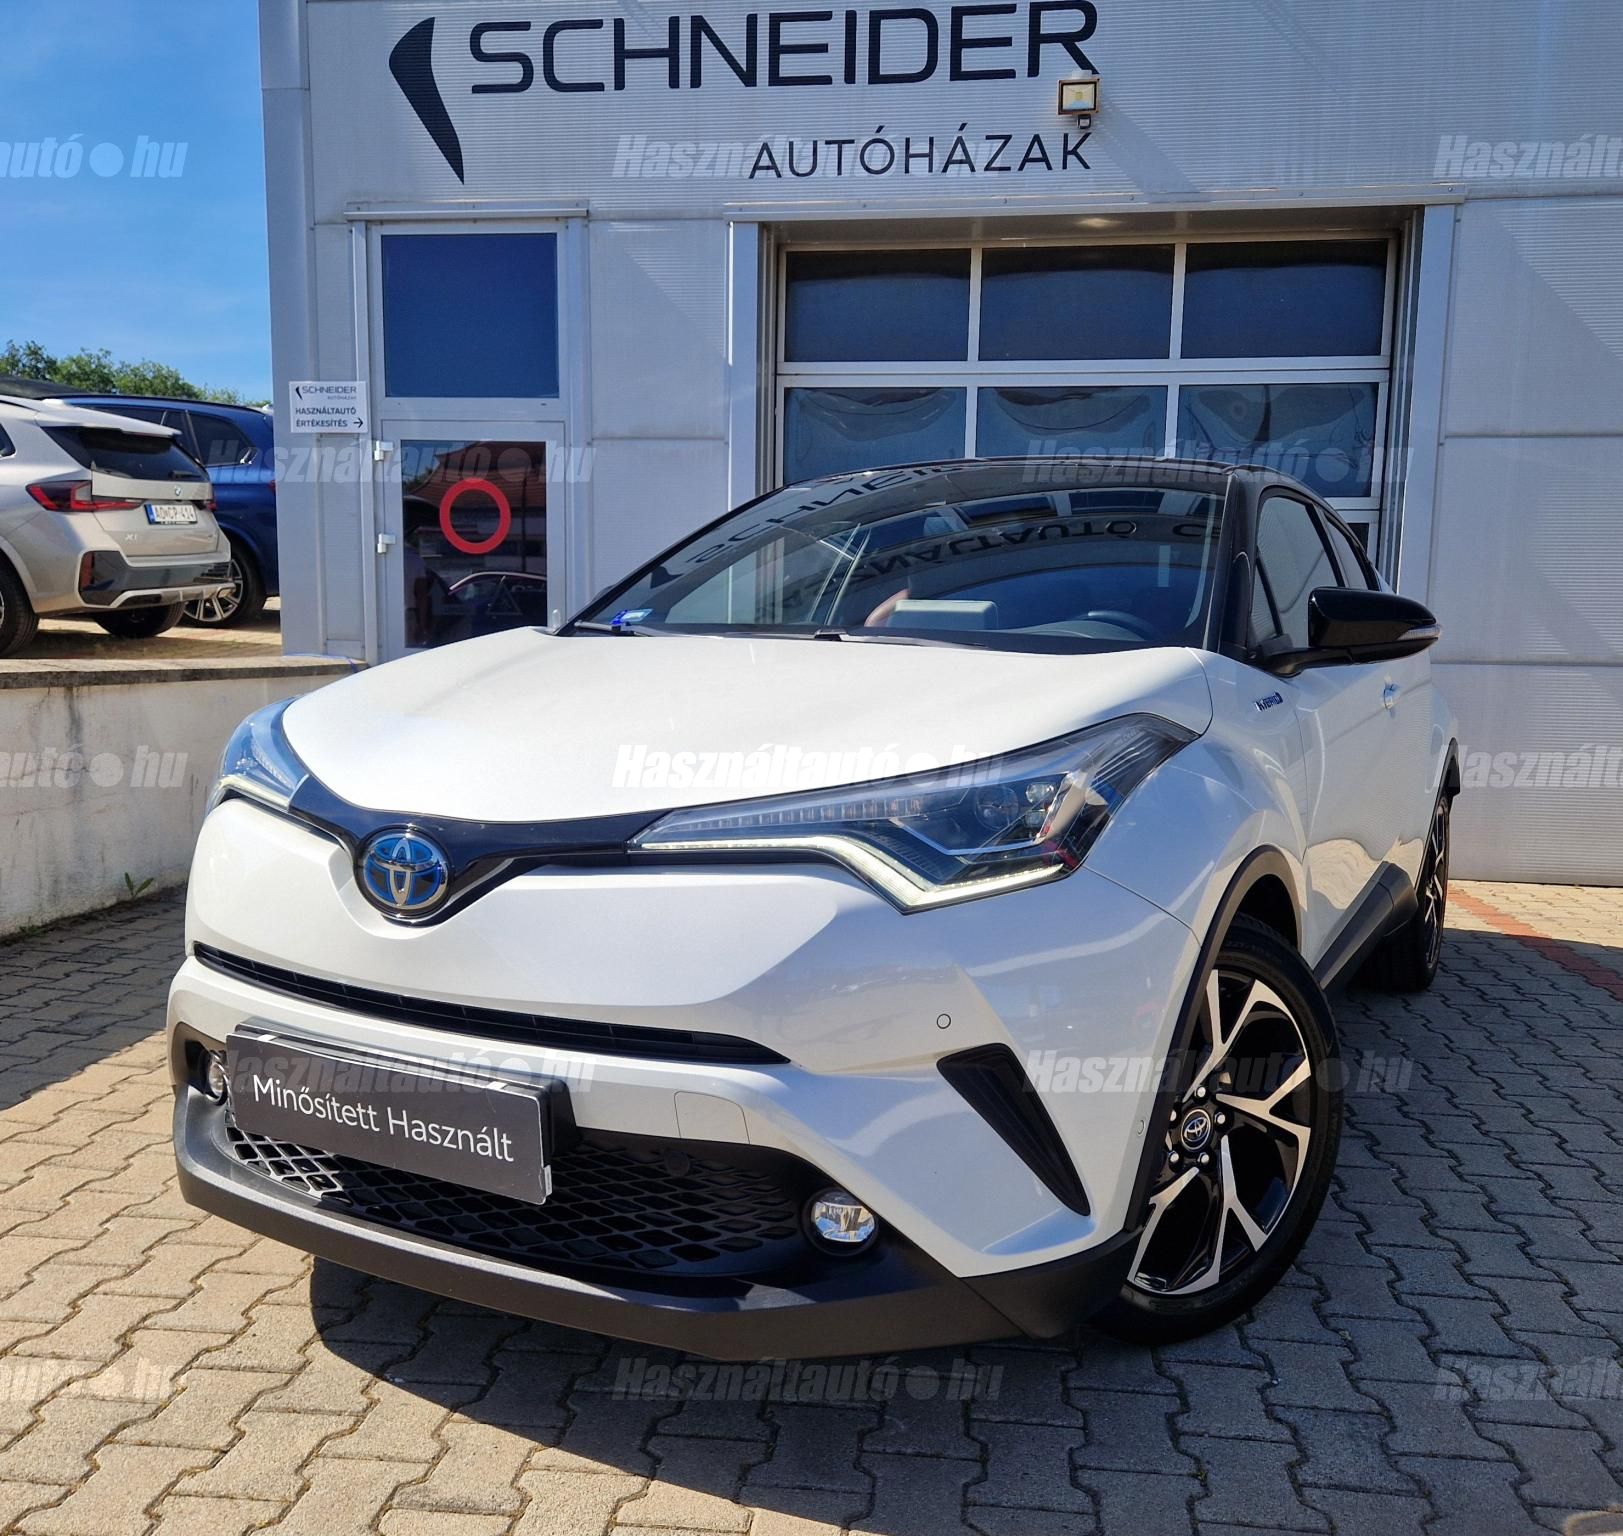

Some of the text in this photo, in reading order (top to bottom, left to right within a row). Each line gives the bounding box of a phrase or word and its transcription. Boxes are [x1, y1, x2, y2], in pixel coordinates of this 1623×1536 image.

[469, 0, 1100, 94] SCHNEIDER
[748, 123, 1091, 179] AUTÓHÁZAK
[302, 386, 357, 394] SCHNEIDER
[295, 406, 357, 415] HASZNÁLTAUTÓ
[296, 418, 348, 428] ÉRTÉKESÍTÉS
[252, 1074, 515, 1164] Minősített Használt
